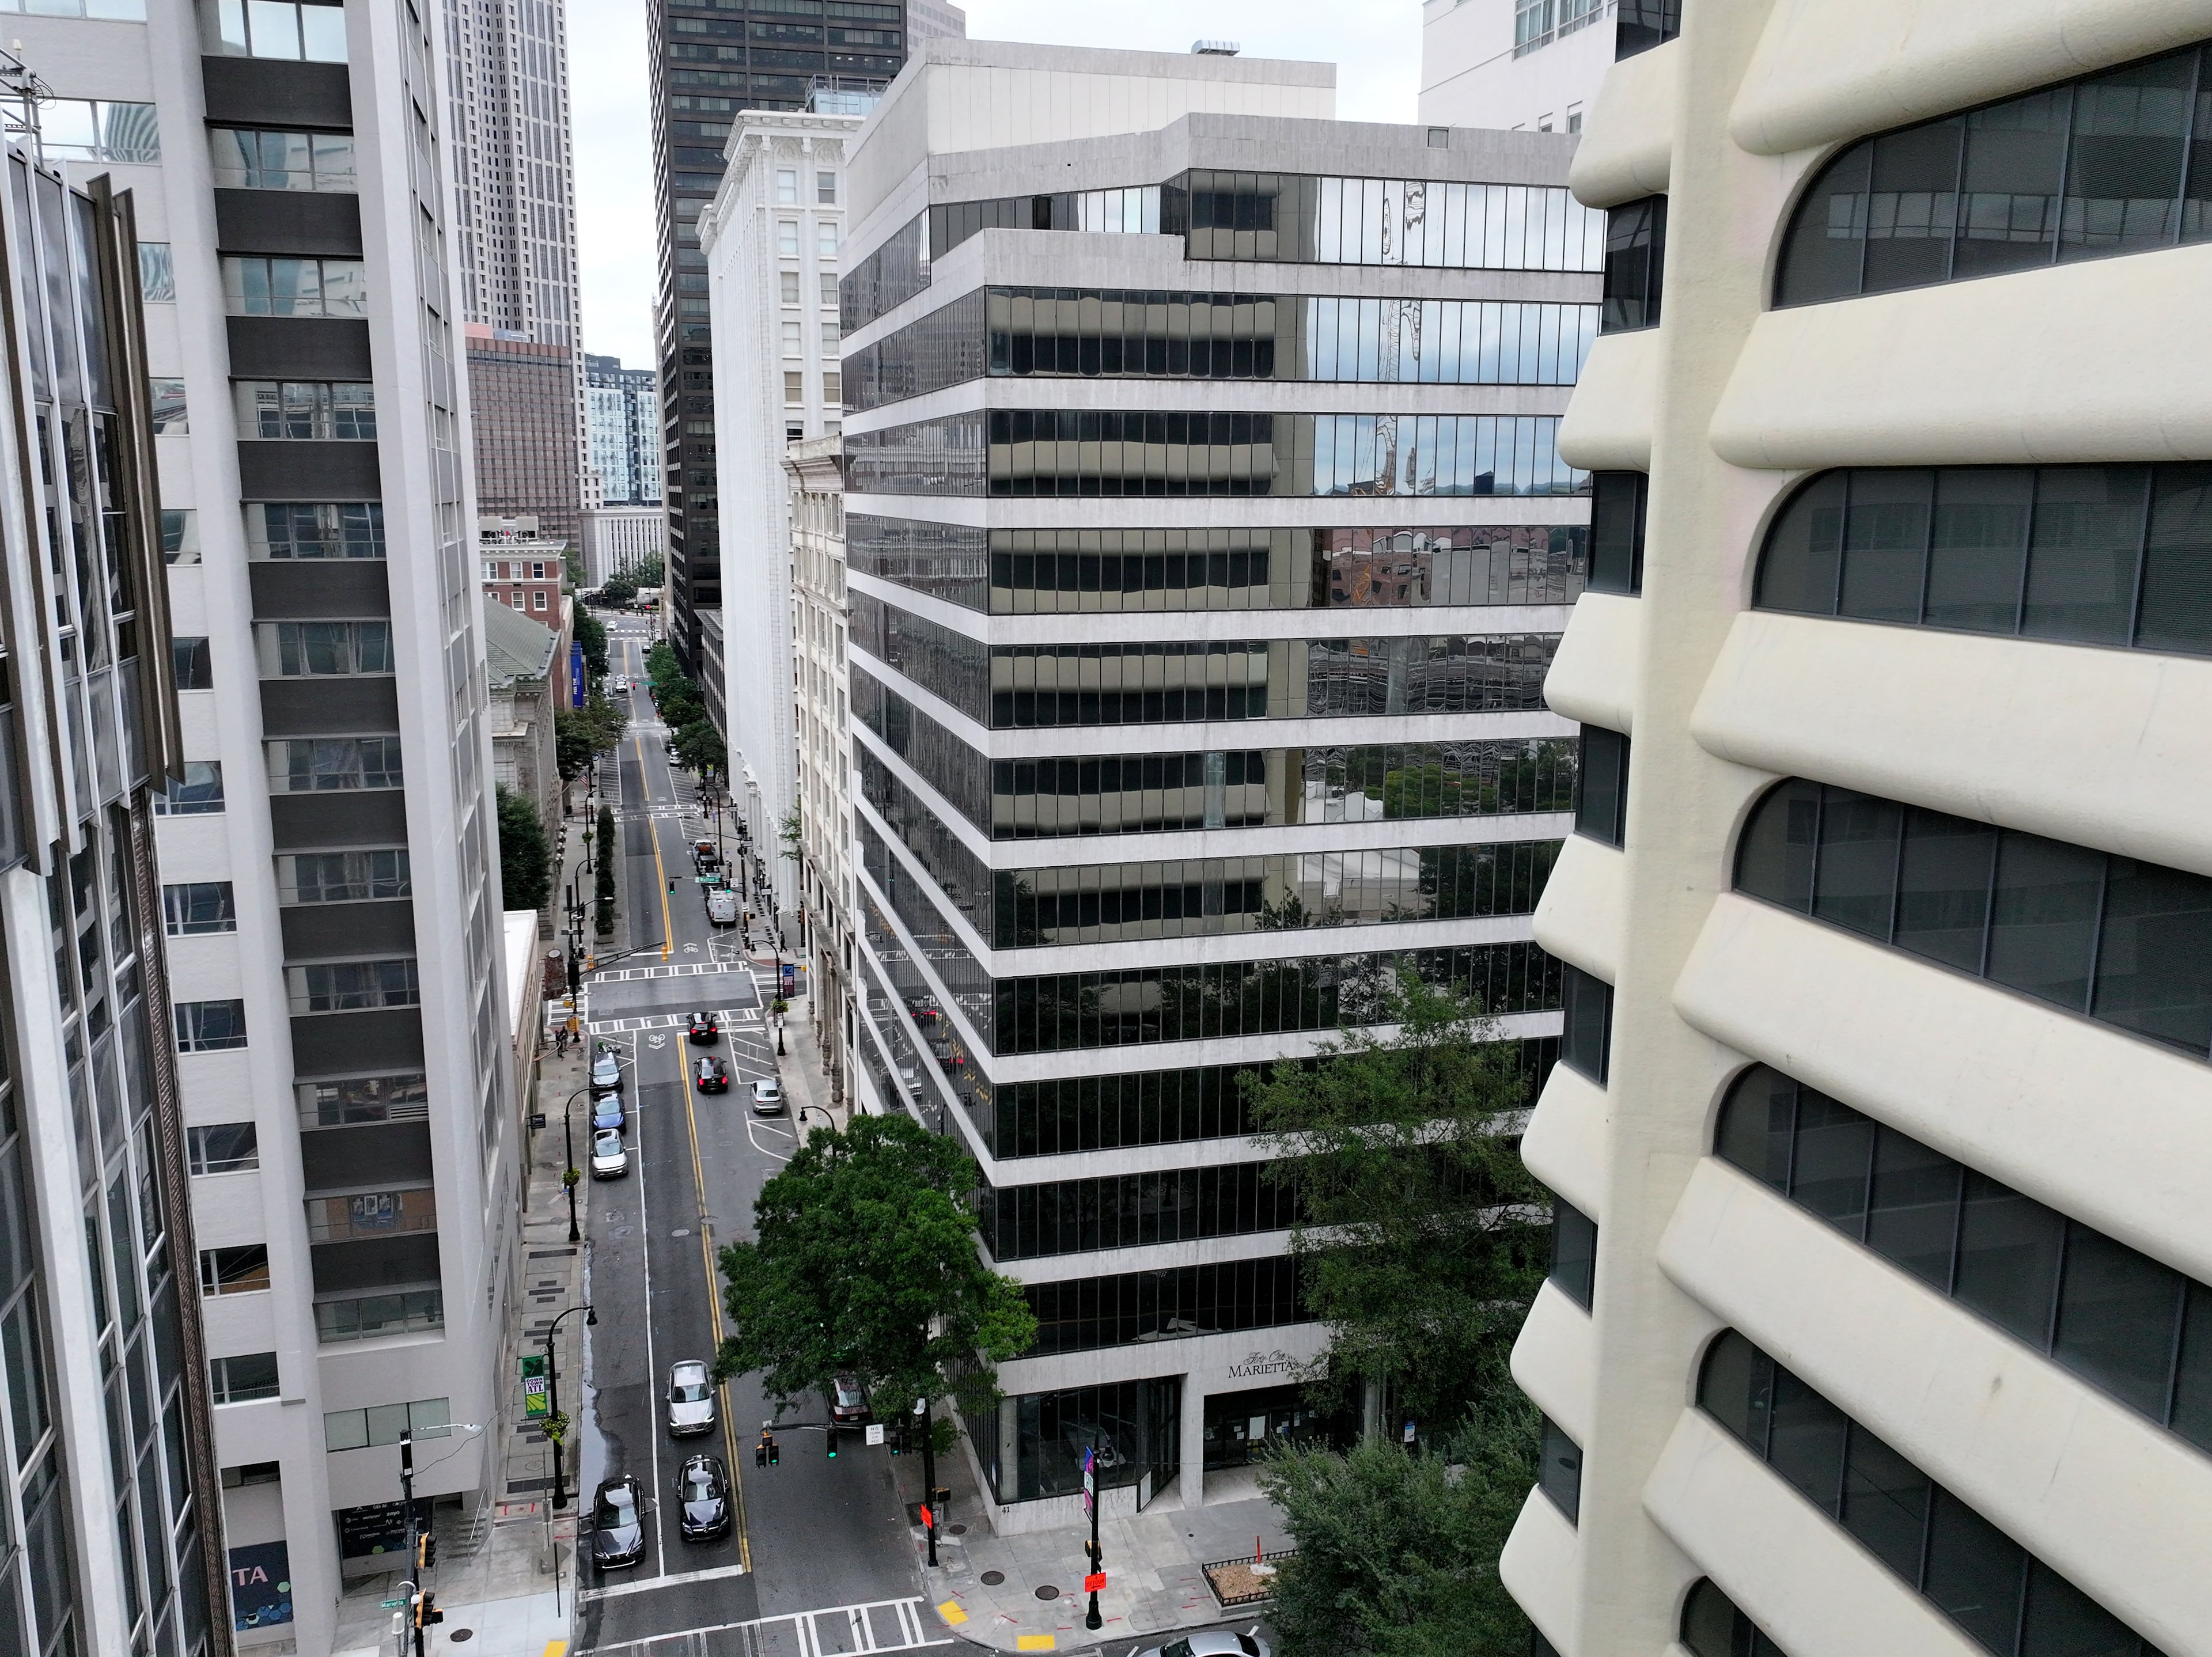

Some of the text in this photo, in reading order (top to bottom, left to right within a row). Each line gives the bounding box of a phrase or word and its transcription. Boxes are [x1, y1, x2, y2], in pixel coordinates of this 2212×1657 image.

[1228, 1360, 1294, 1378] MARIETTA
[528, 1385, 544, 1393] ATL
[1086, 1579, 1105, 1587] DETOUR
